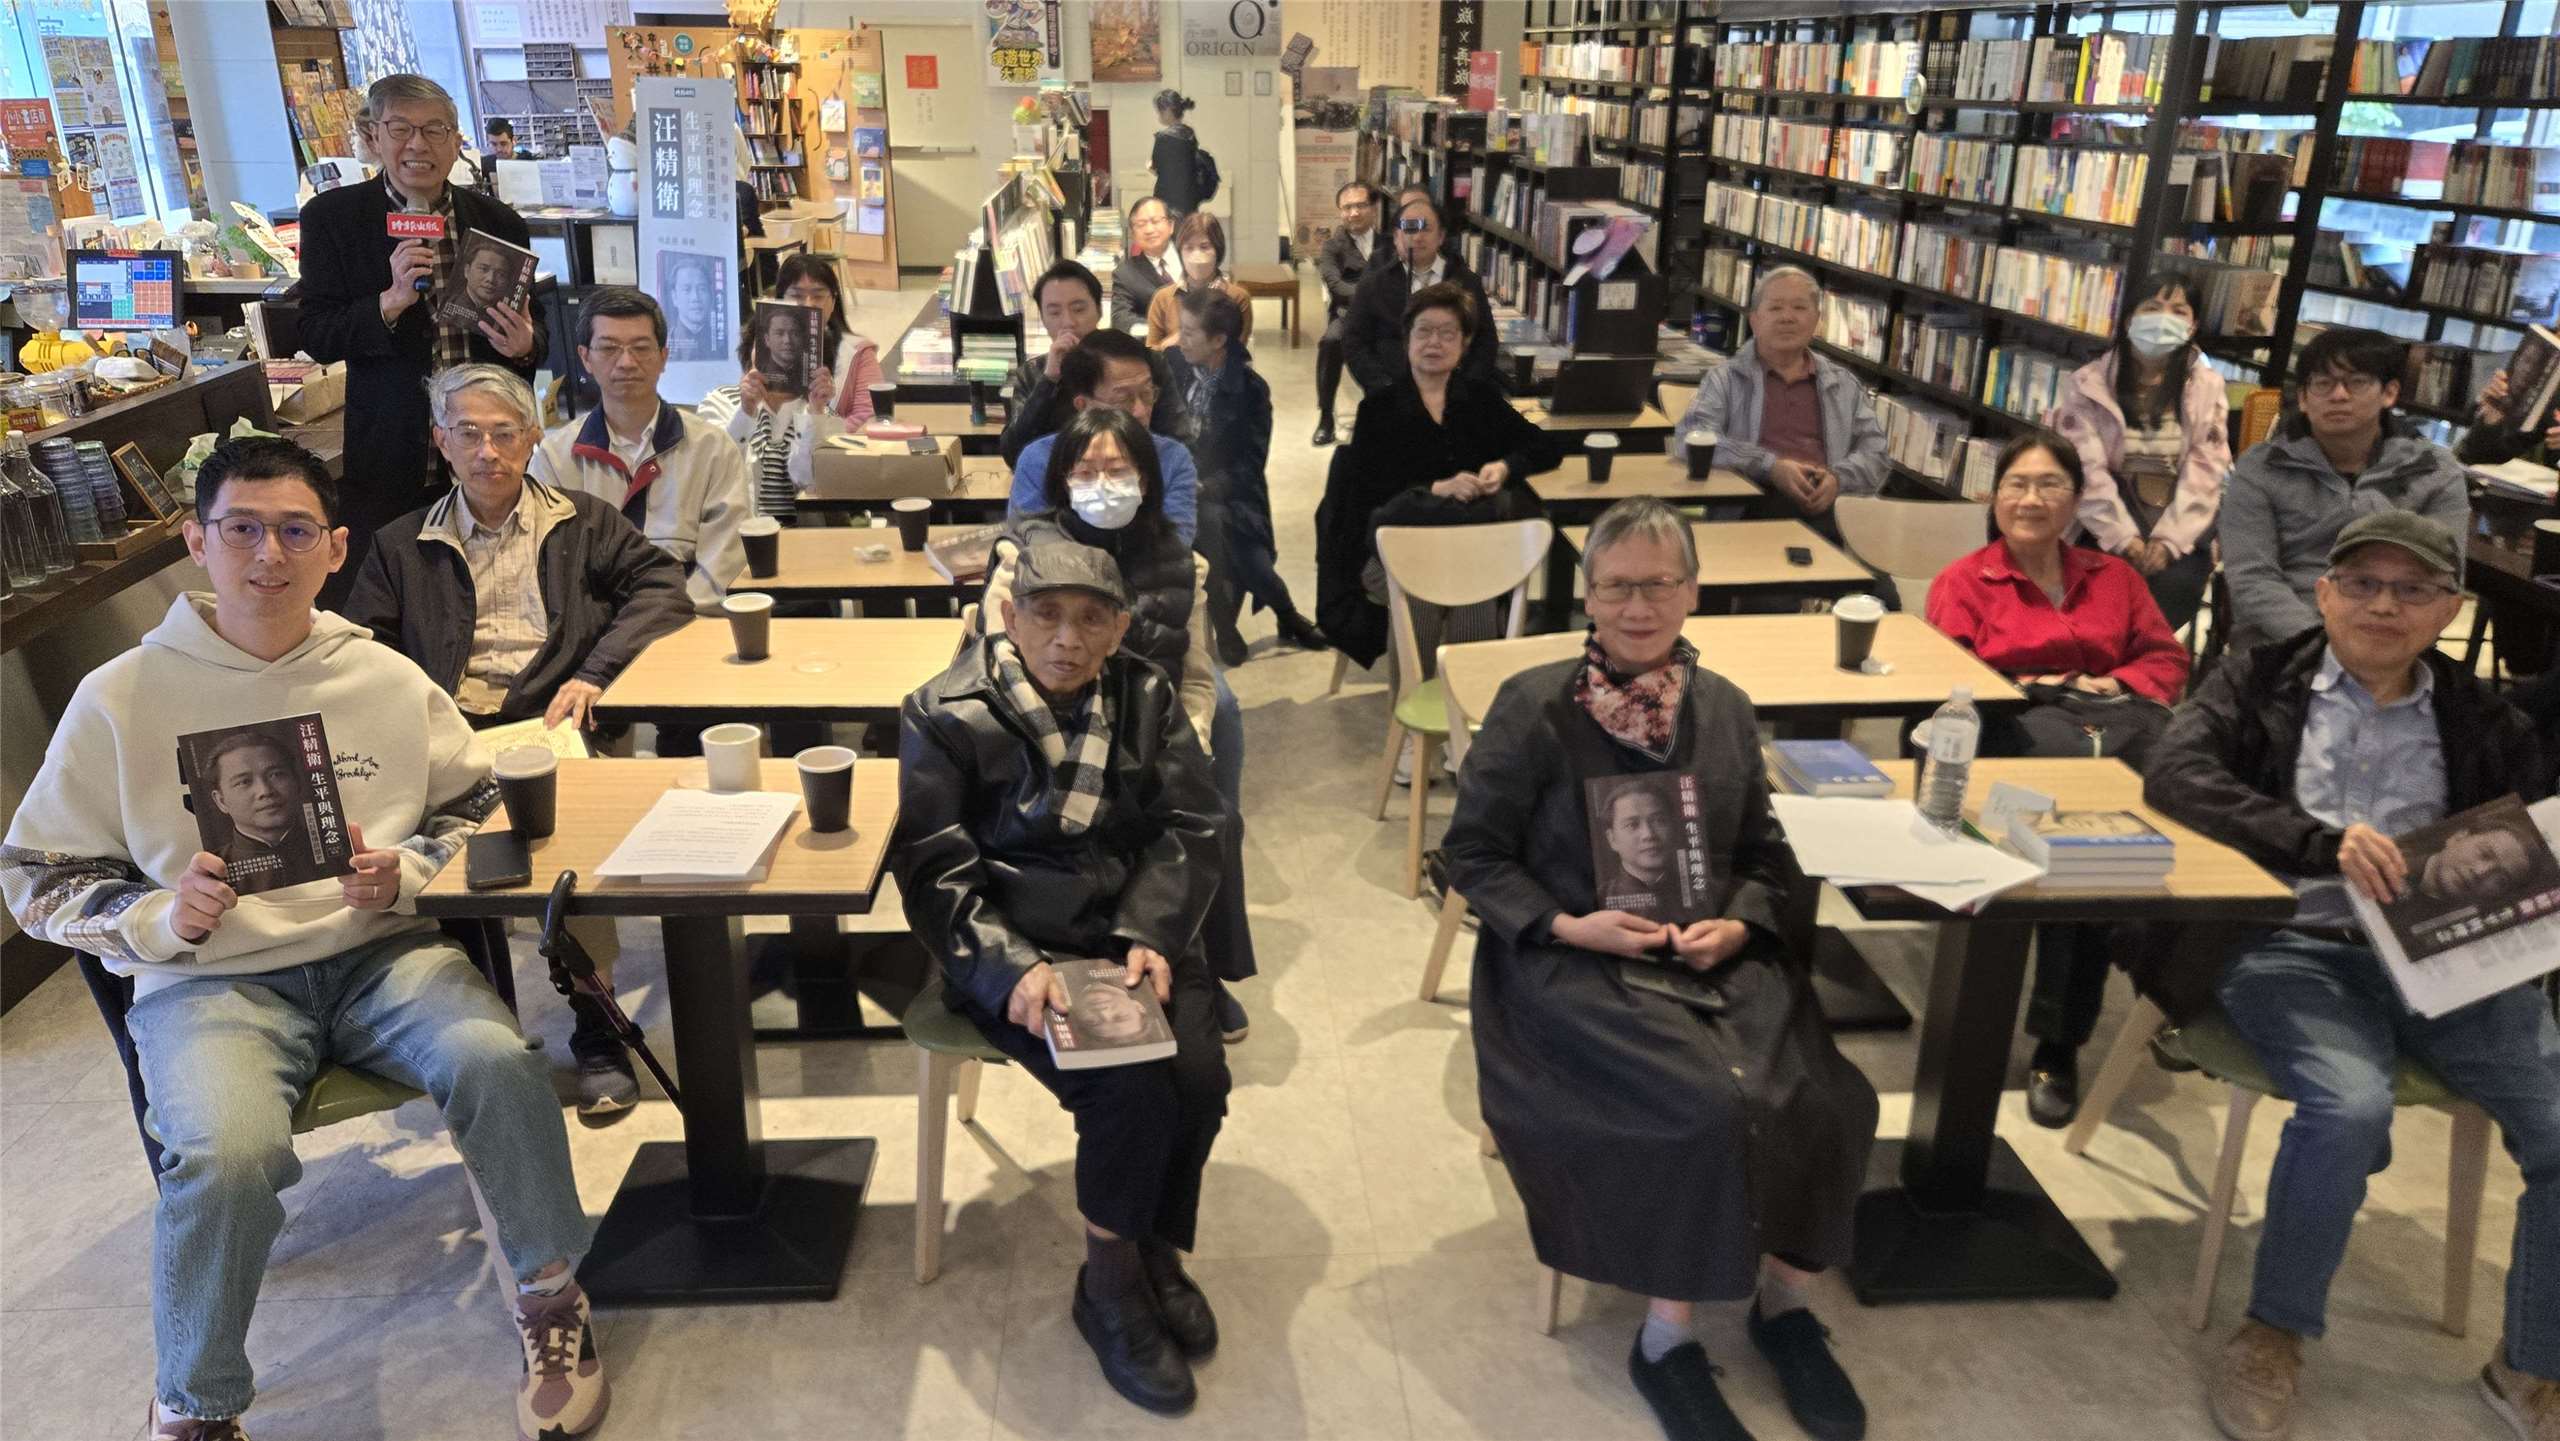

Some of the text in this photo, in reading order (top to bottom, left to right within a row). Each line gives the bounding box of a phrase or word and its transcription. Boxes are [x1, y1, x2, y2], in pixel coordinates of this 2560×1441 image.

[1455, 0, 1475, 25] 版
[1185, 39, 1255, 56] ORIGIN
[653, 111, 681, 212] 汪精衛
[684, 110, 704, 218] 生平與理念
[298, 722, 323, 767] 汪精衛
[310, 770, 341, 846] 生平與理念
